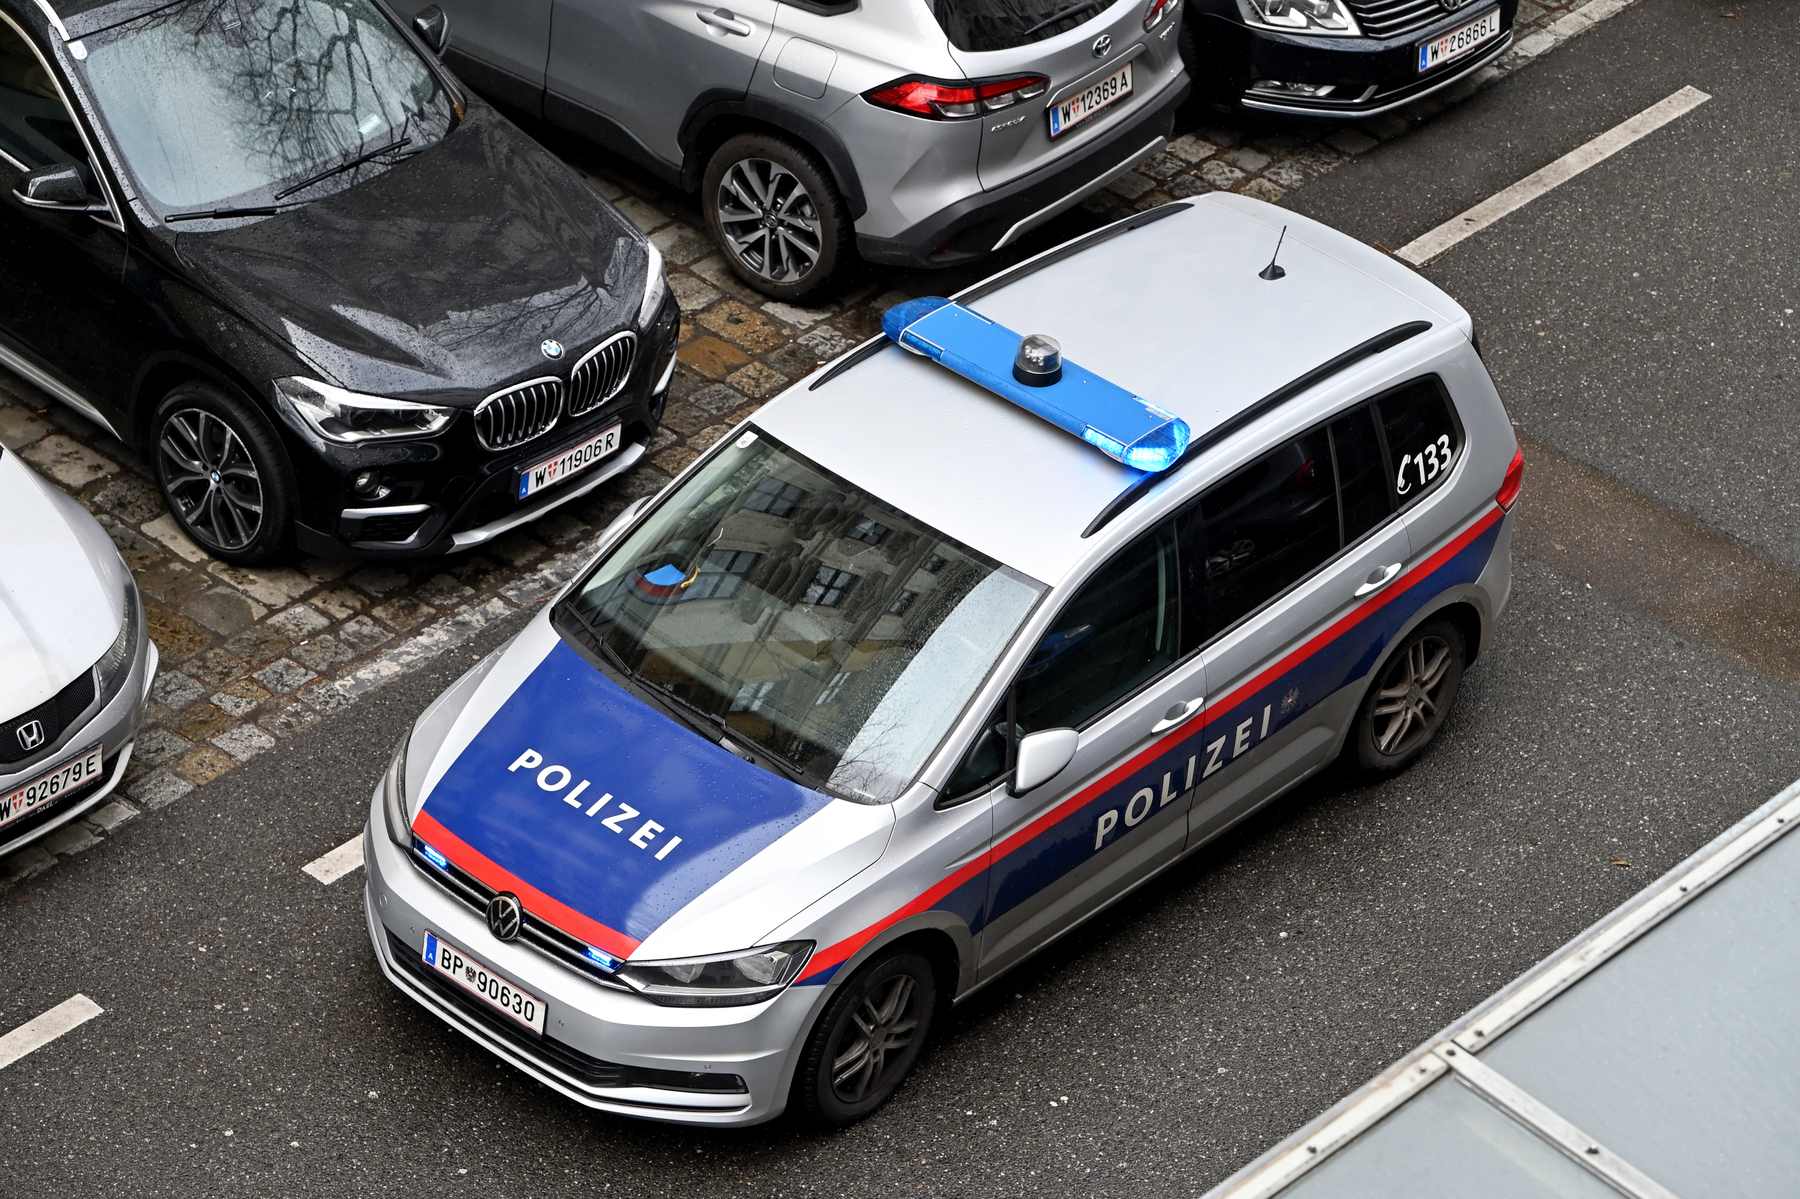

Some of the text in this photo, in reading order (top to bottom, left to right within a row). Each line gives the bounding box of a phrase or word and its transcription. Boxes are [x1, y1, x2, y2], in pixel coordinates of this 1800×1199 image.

[1430, 42, 1440, 61] W
[1449, 19, 1487, 53] 26866
[1489, 16, 1496, 32] L
[1061, 103, 1071, 124] W
[1080, 77, 1117, 113] 12369
[1120, 71, 1128, 92] A
[535, 467, 547, 488] W
[559, 438, 602, 475] 11906
[605, 432, 614, 452] R
[1413, 434, 1452, 486] 133
[0, 797, 11, 822] W
[26, 762, 82, 807] 92679
[86, 754, 96, 776] E
[507, 748, 683, 861] POLIZEI
[1094, 704, 1272, 851] POLIZEI
[441, 948, 464, 975] BP
[476, 971, 535, 1022] 90630
